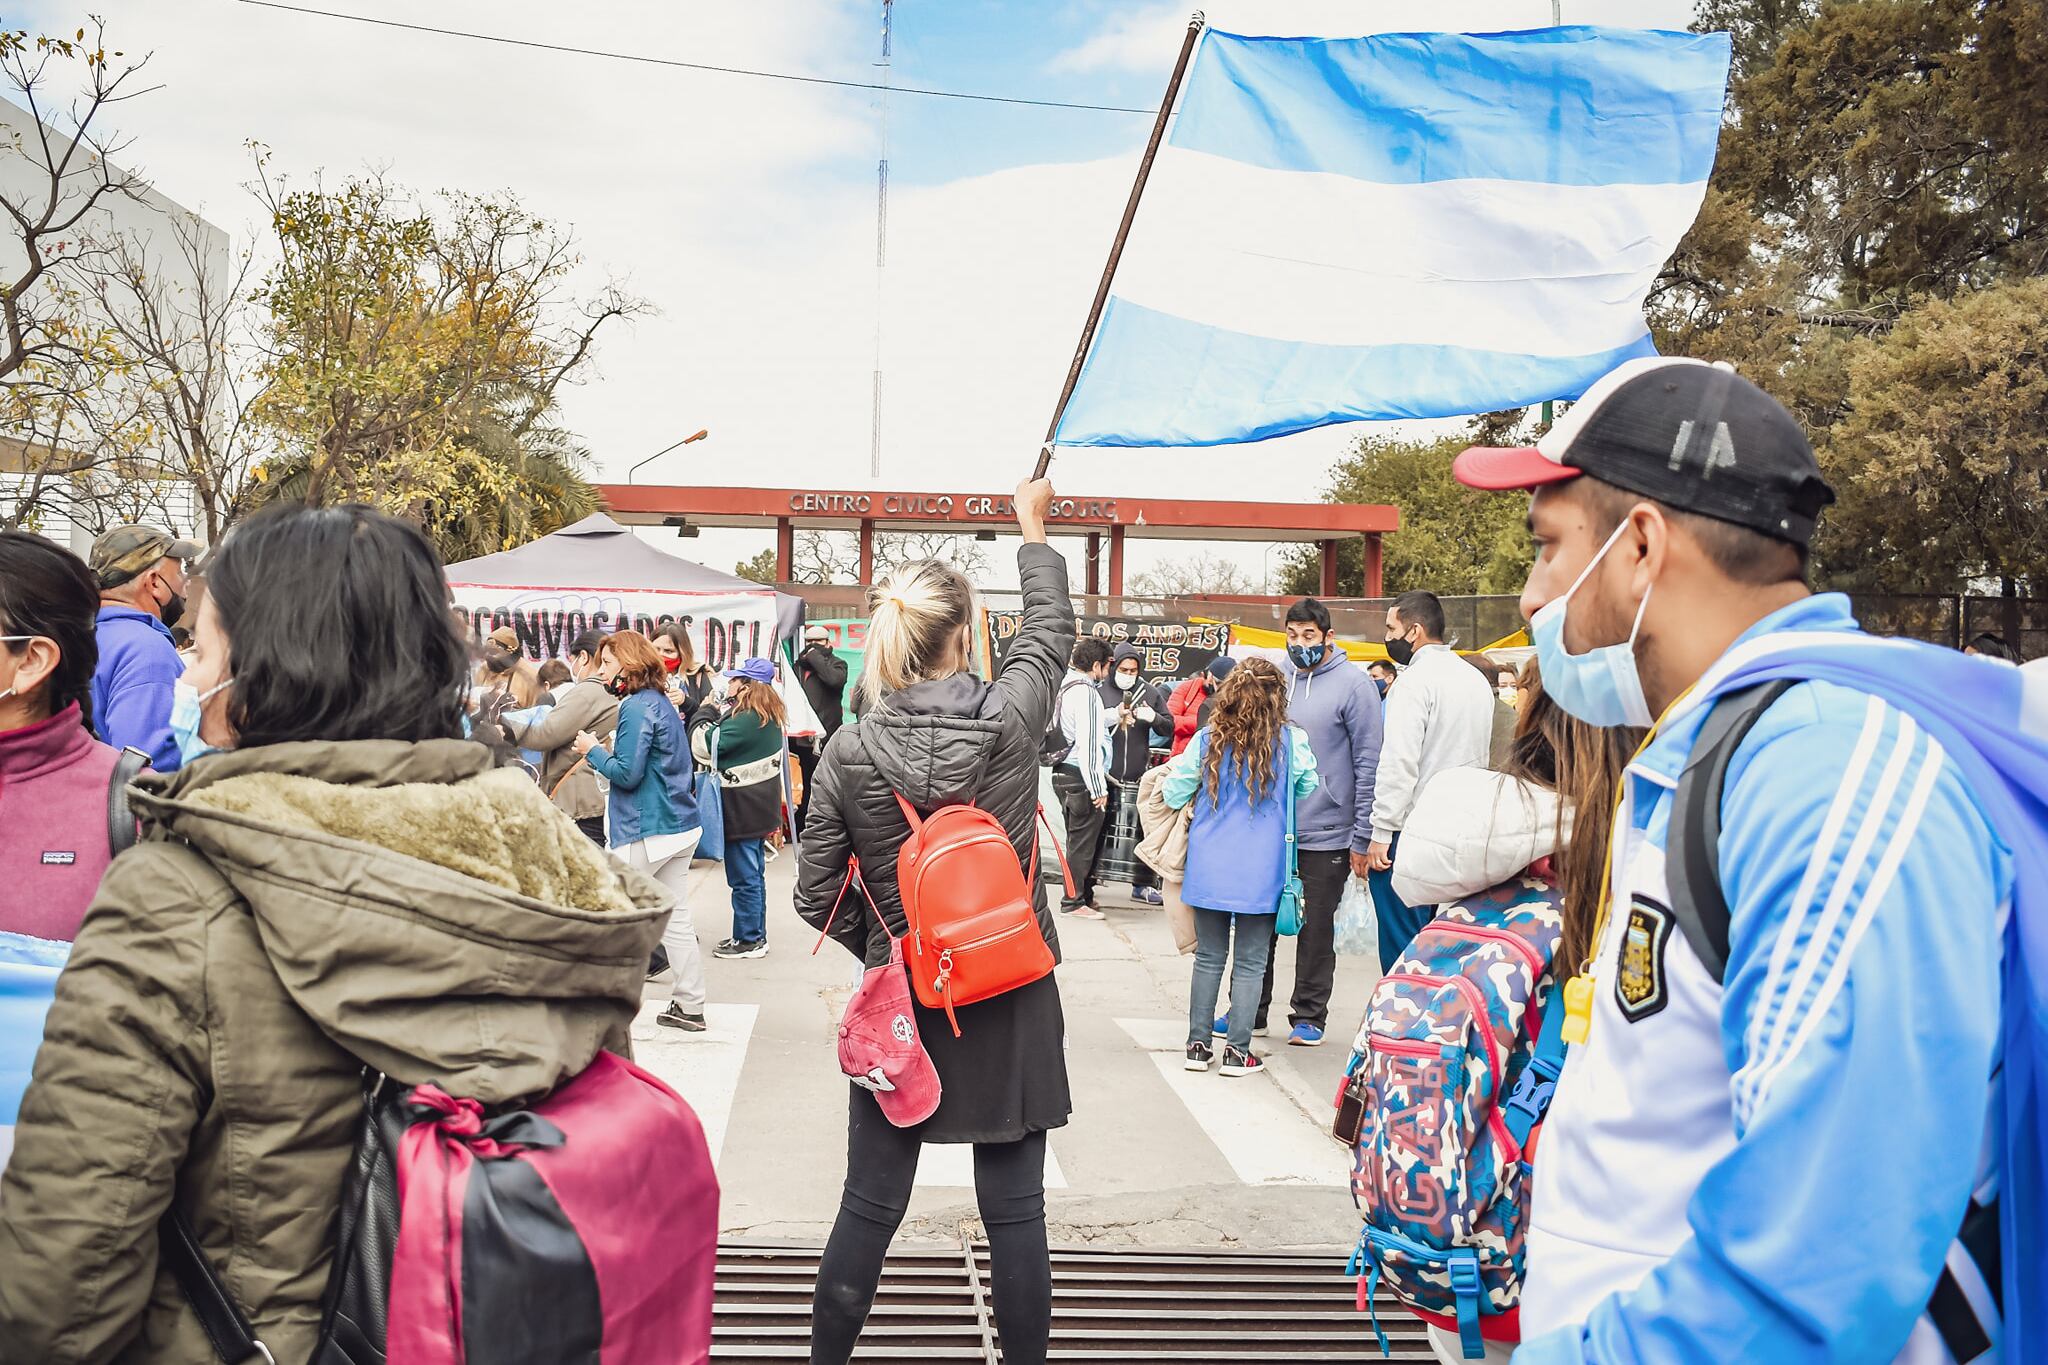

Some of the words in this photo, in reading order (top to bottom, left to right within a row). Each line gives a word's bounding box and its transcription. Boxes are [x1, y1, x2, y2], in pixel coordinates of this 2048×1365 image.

[789, 494, 871, 513] CENTRO
[884, 495, 953, 514] CIVICO
[965, 497, 1017, 515] GRAN
[1049, 499, 1117, 519] BOURG
[1132, 624, 1220, 651] ANDES
